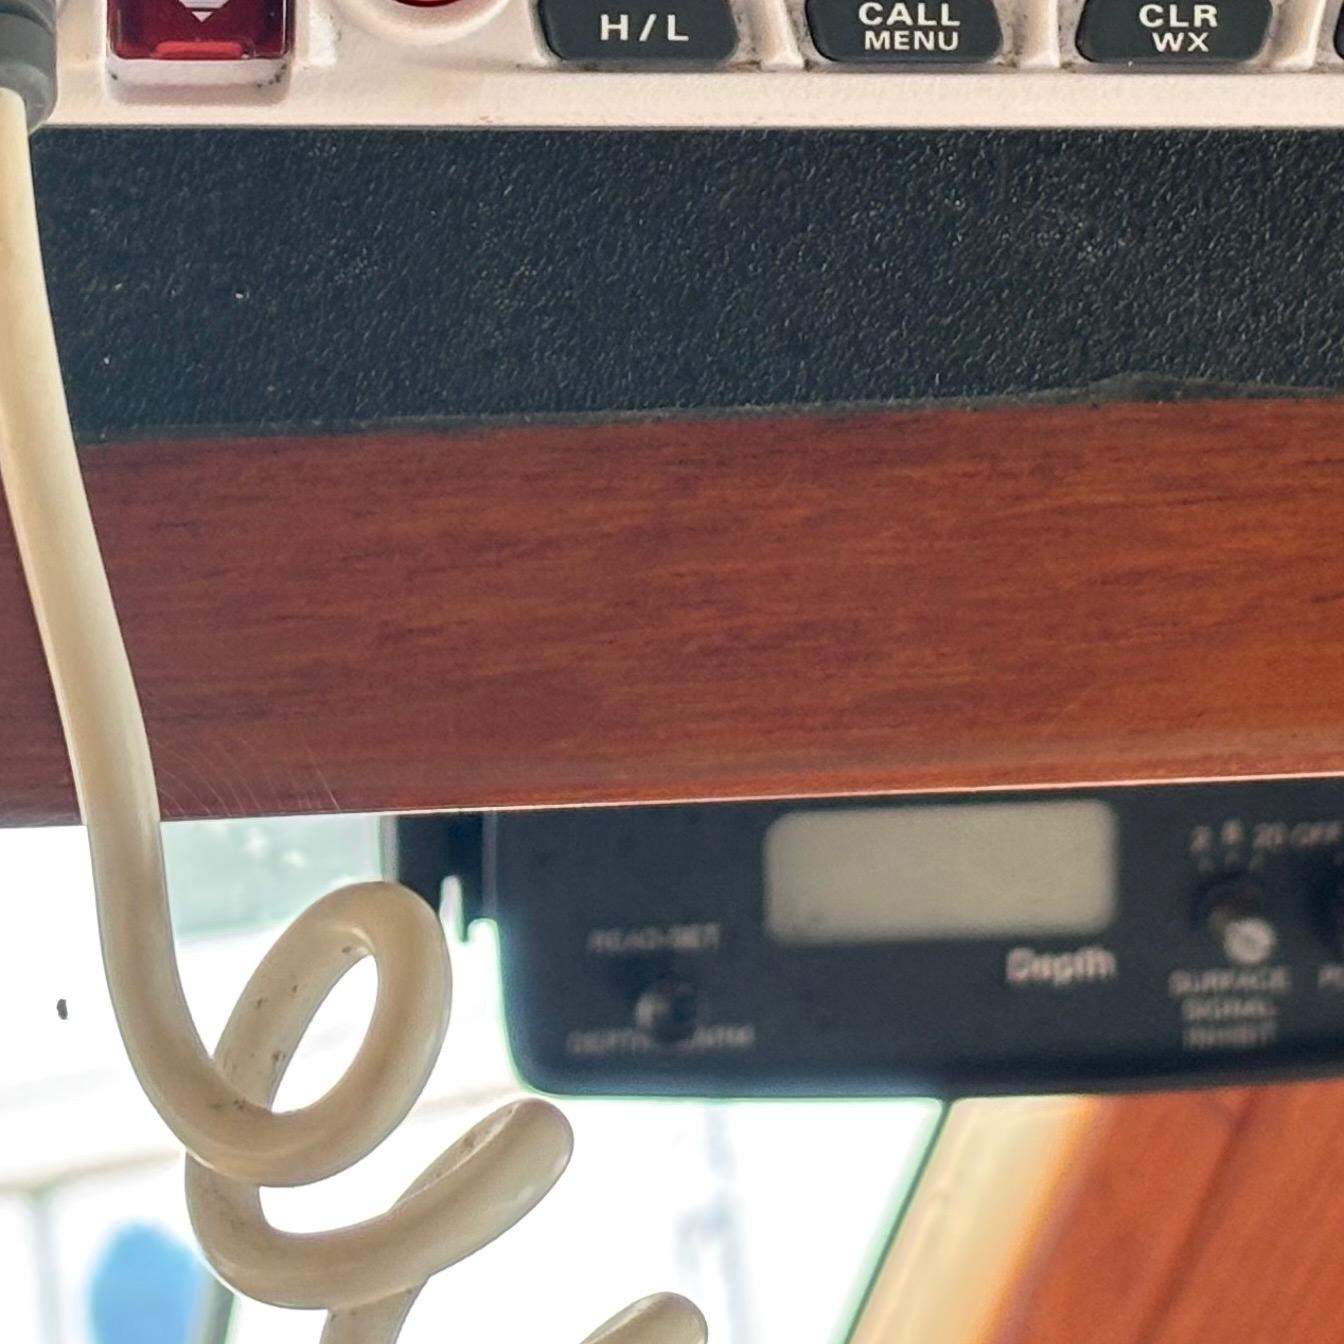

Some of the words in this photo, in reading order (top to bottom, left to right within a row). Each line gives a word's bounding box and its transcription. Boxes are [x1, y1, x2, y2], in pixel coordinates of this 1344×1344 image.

[858, 0, 962, 29] CALL
[1137, 2, 1219, 30] CLR
[863, 29, 961, 53] MENU
[1151, 32, 1210, 54] WX
[1006, 945, 1117, 987] Depth
